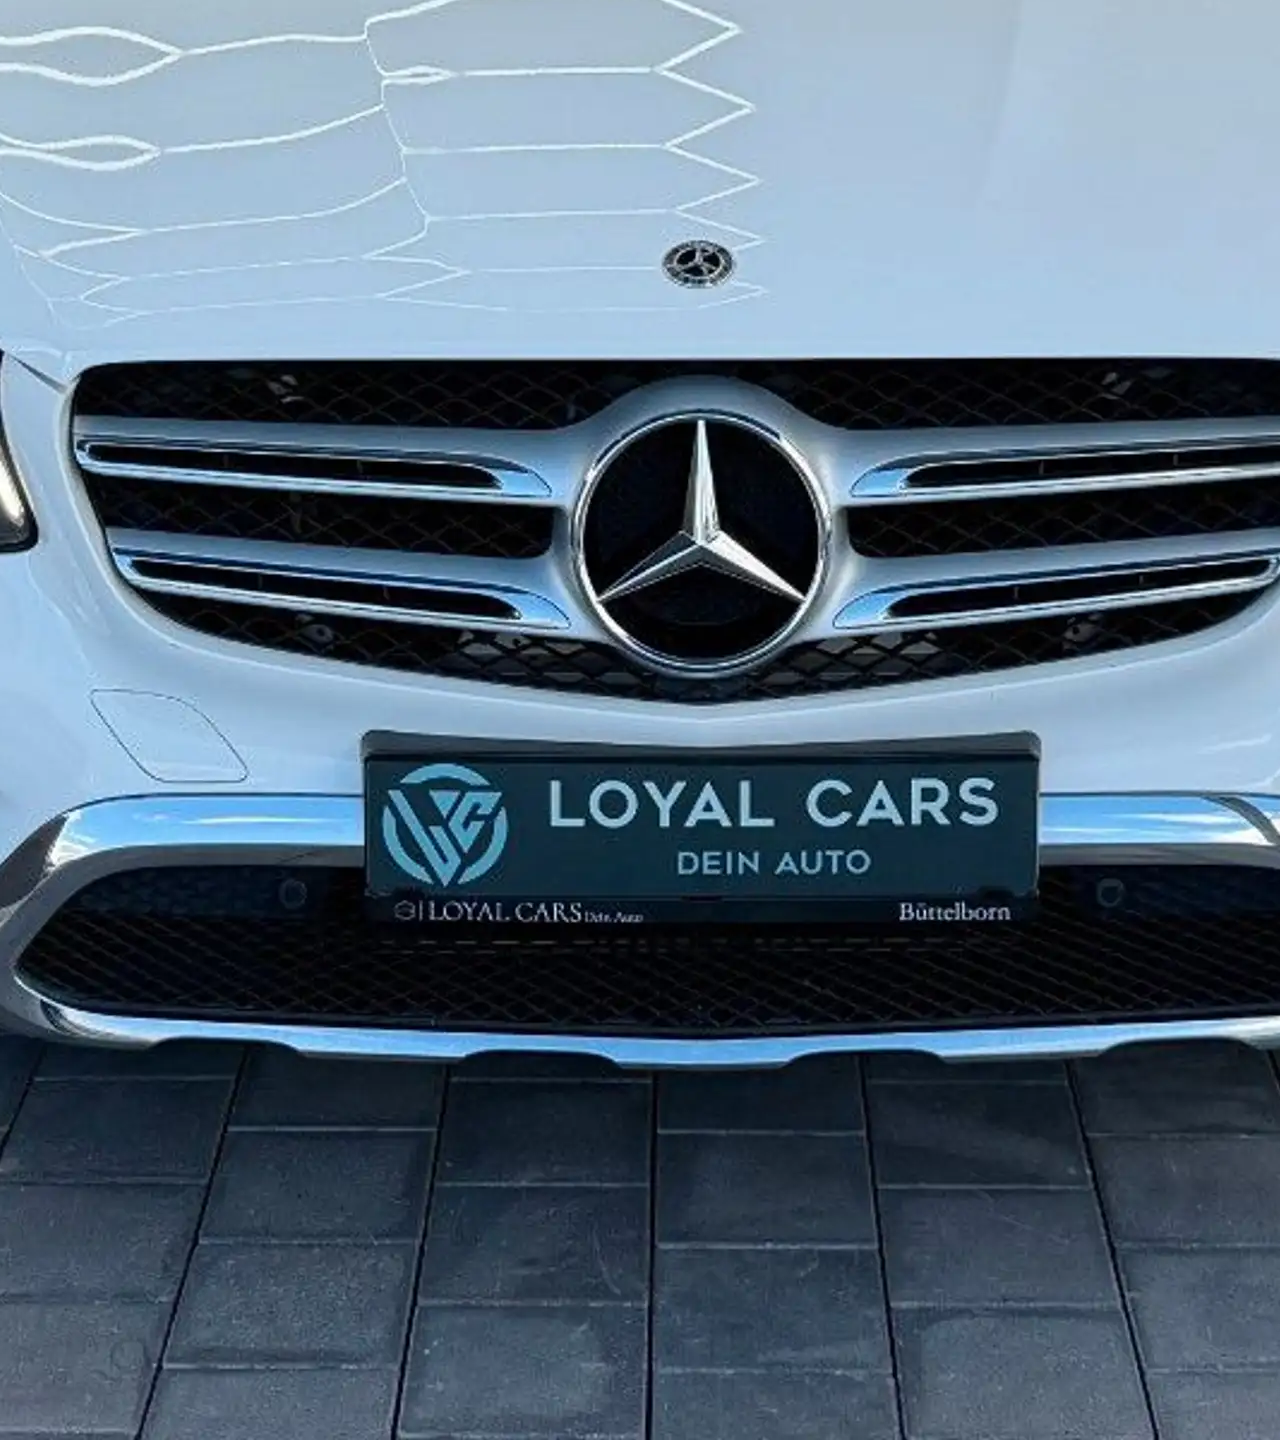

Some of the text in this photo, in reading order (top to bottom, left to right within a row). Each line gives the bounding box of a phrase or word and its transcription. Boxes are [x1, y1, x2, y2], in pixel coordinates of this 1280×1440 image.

[549, 776, 1000, 829] LOYAL CARS
[677, 849, 872, 876] DEIN AUTO
[428, 900, 511, 921] LOYAL
[514, 901, 582, 923] CARS
